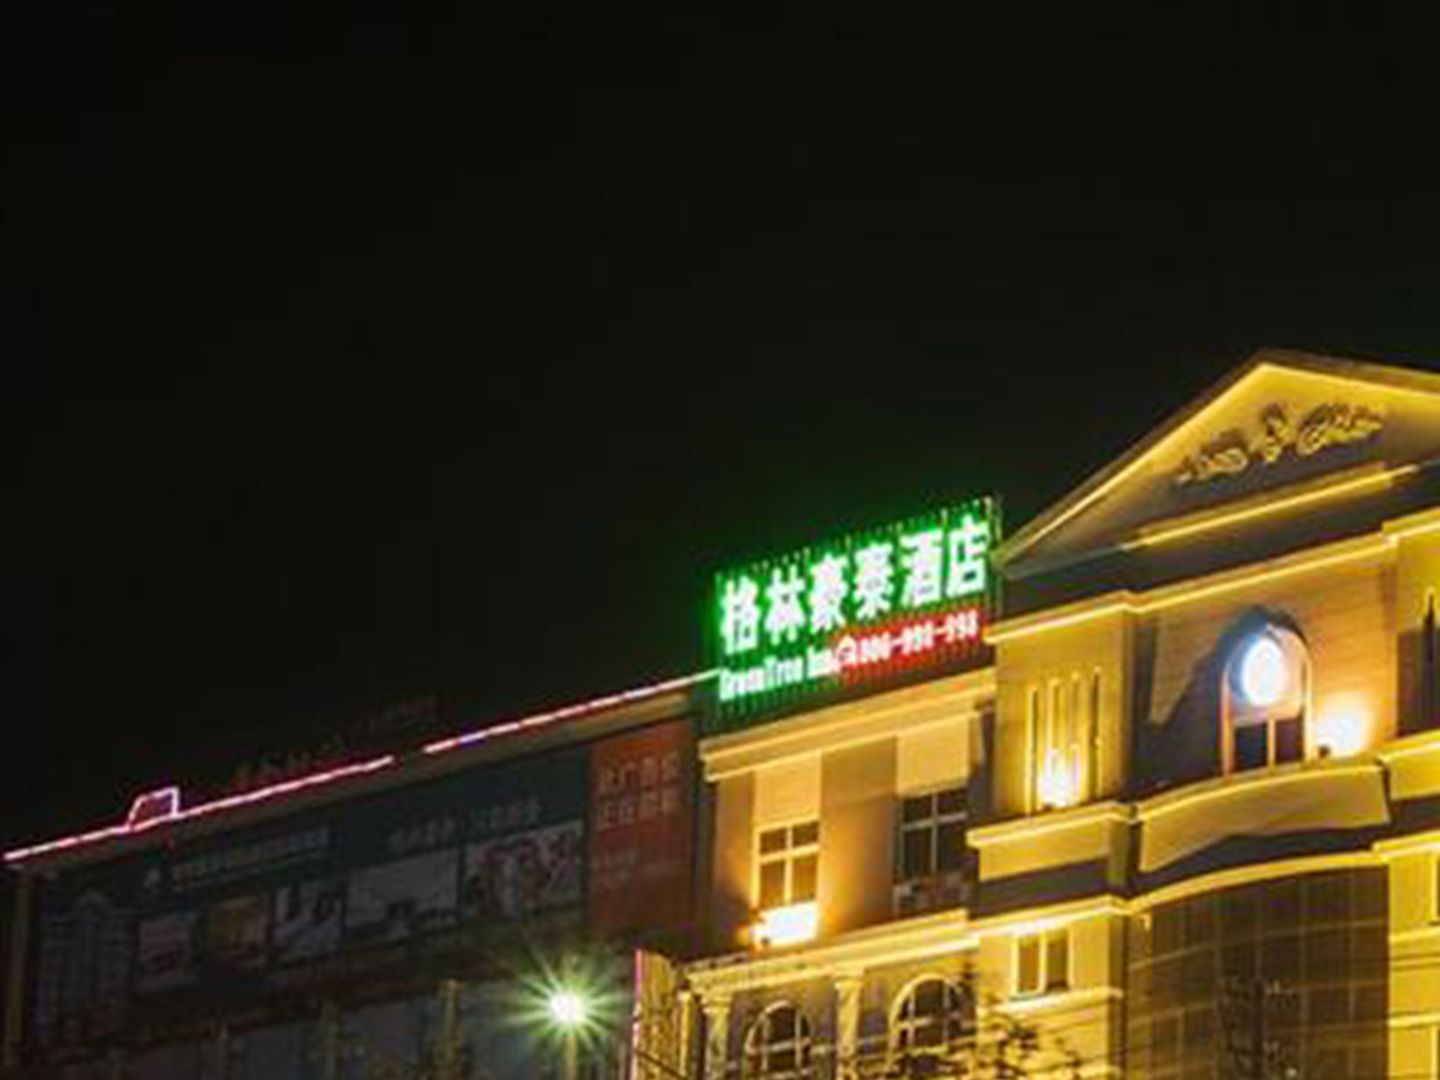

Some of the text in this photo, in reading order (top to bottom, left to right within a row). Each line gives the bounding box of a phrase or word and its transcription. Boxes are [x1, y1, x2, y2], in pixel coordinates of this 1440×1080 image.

[720, 514, 991, 654] 格林豪泰酒店
